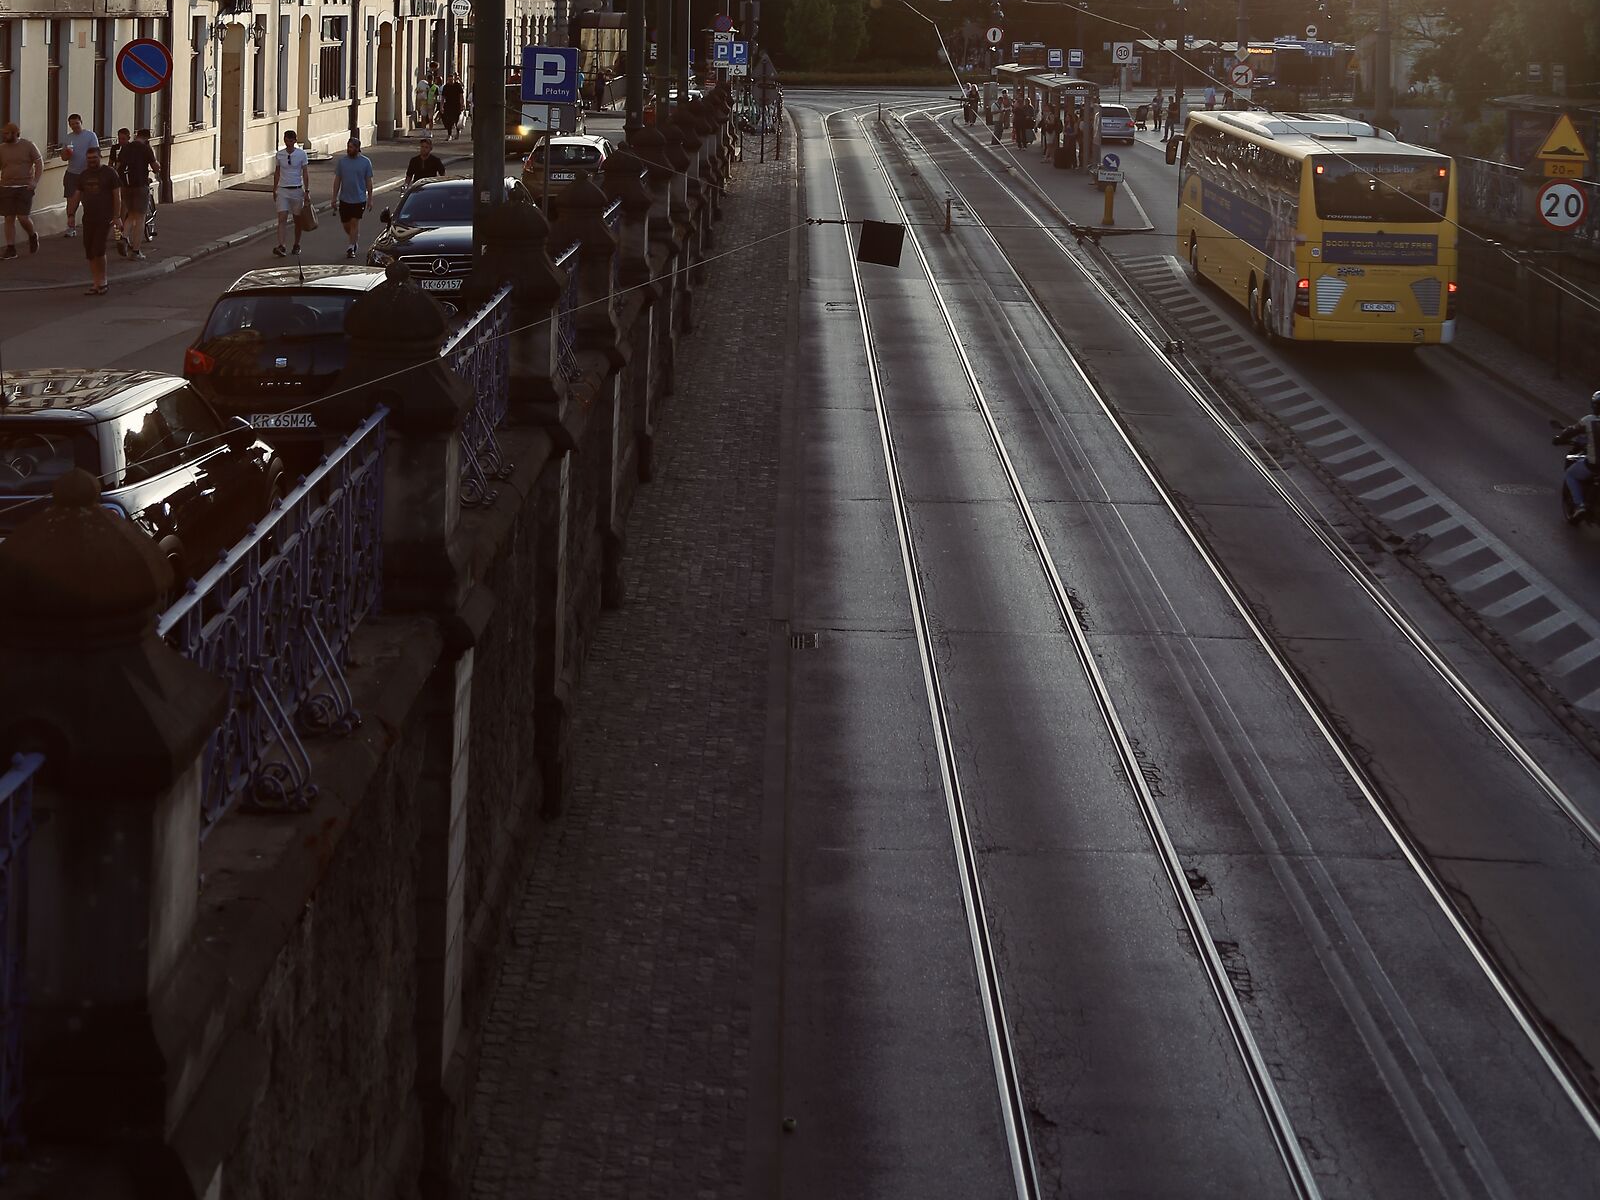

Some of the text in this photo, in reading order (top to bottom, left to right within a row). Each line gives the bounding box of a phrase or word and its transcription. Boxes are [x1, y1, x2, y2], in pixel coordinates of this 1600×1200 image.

[718, 45, 728, 58] P
[733, 43, 744, 58] P
[534, 53, 566, 95] P
[545, 88, 570, 97] Płatny
[1552, 164, 1566, 175] 20
[1544, 193, 1580, 218] 20
[423, 280, 462, 289] KK 69157
[252, 415, 267, 427] KR
